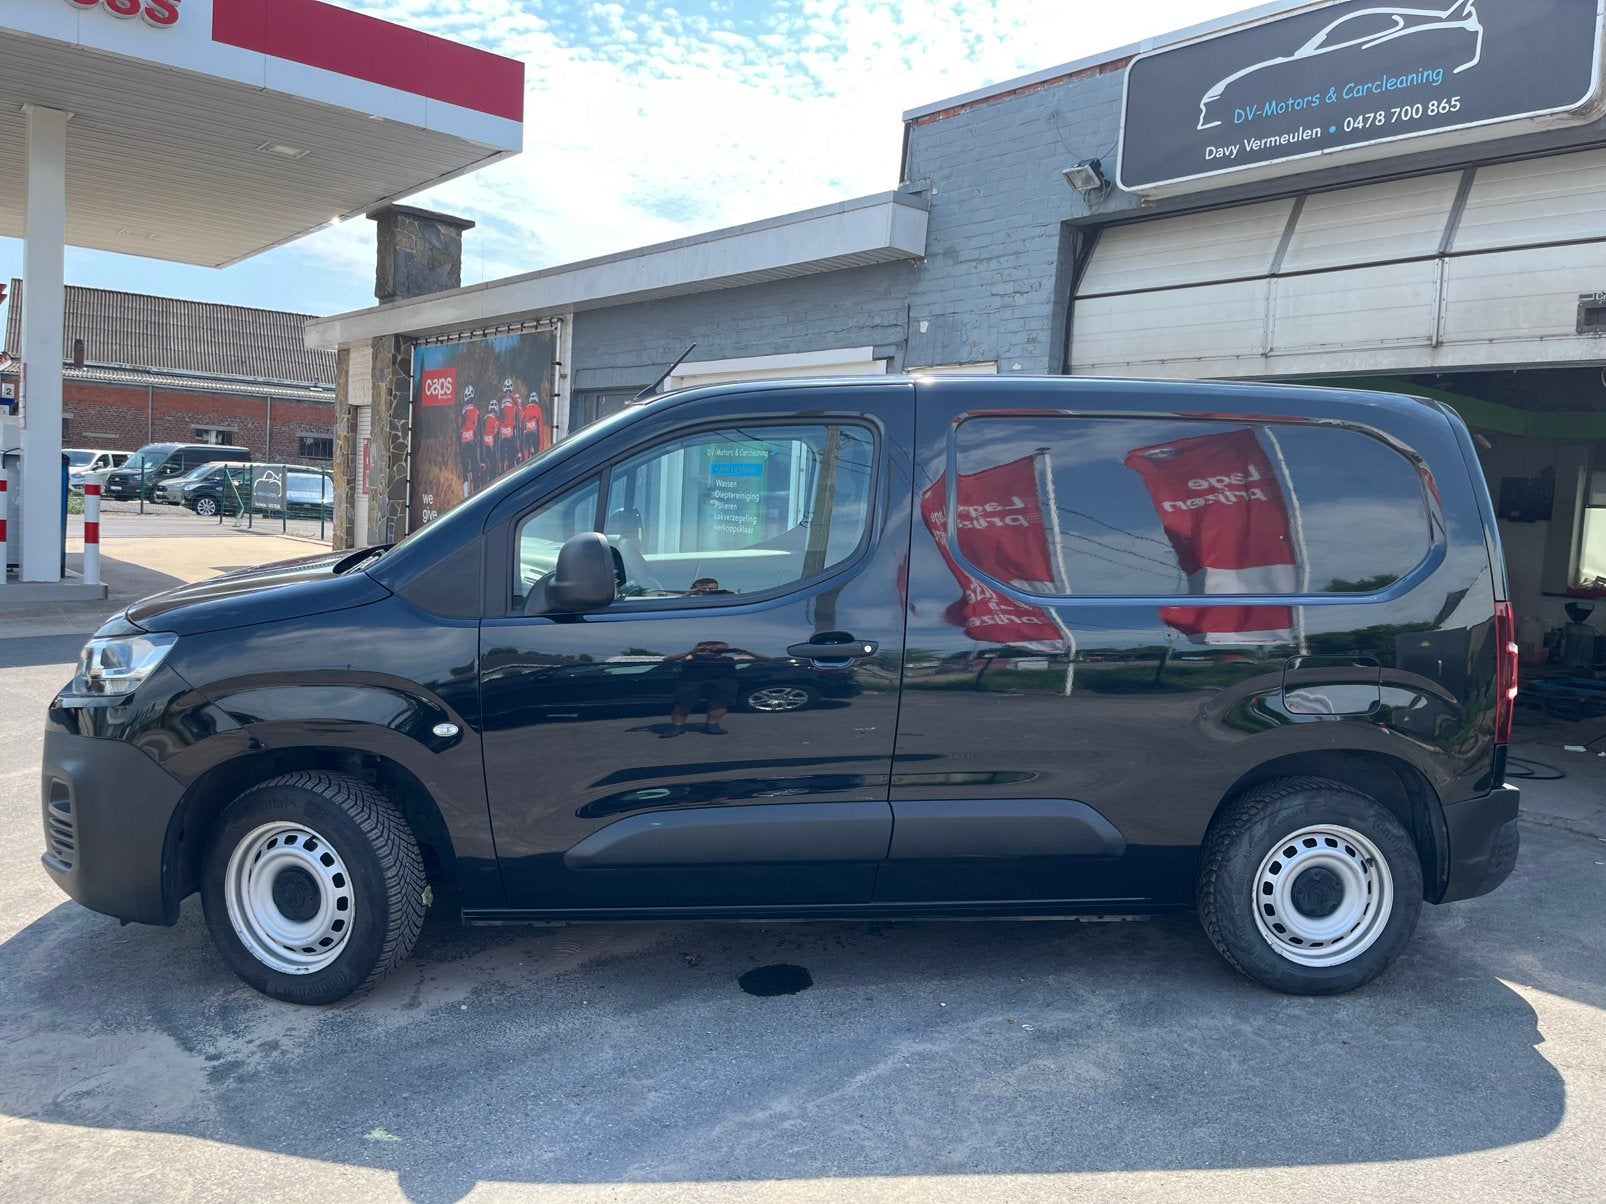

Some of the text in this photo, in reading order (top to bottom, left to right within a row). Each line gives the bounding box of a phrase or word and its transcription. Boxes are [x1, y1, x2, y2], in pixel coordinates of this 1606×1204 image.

[1234, 68, 1444, 124] DV-Motors & Carcleaning
[1205, 96, 1461, 160] Davy Vermeulen 0478 700 865
[425, 377, 453, 399] caps
[716, 479, 737, 488] Wassen
[422, 493, 434, 505] we
